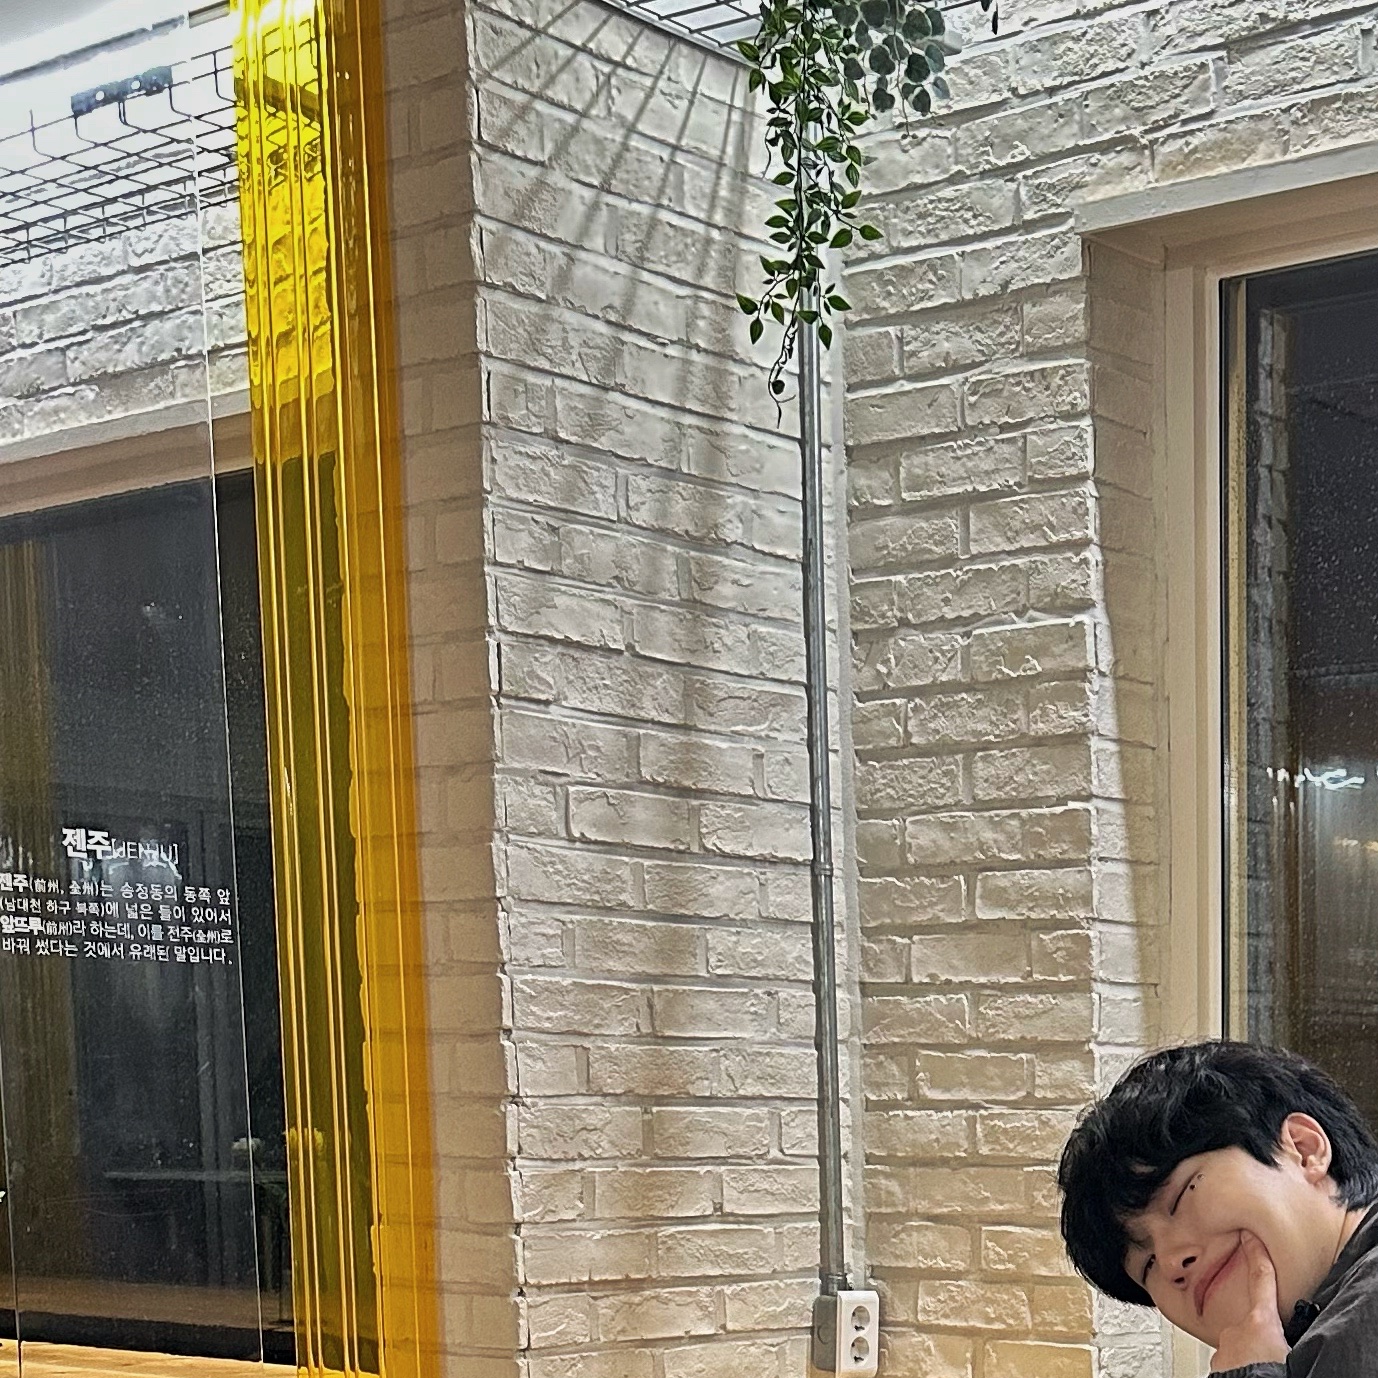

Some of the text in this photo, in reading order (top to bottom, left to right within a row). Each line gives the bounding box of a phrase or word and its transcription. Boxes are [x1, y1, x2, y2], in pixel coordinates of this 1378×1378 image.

[120, 882, 178, 902] 송정동의
[184, 885, 212, 905] 동쪽
[216, 888, 231, 906] 앞
[0, 896, 232, 926] (남대천 하구 북쪽)에 넓은 들이 있어서
[90, 920, 134, 941] 하는데,
[138, 923, 164, 942] 이를
[2, 937, 233, 965] 바꿔 썼다는 것에서 유래된 말입니다.
